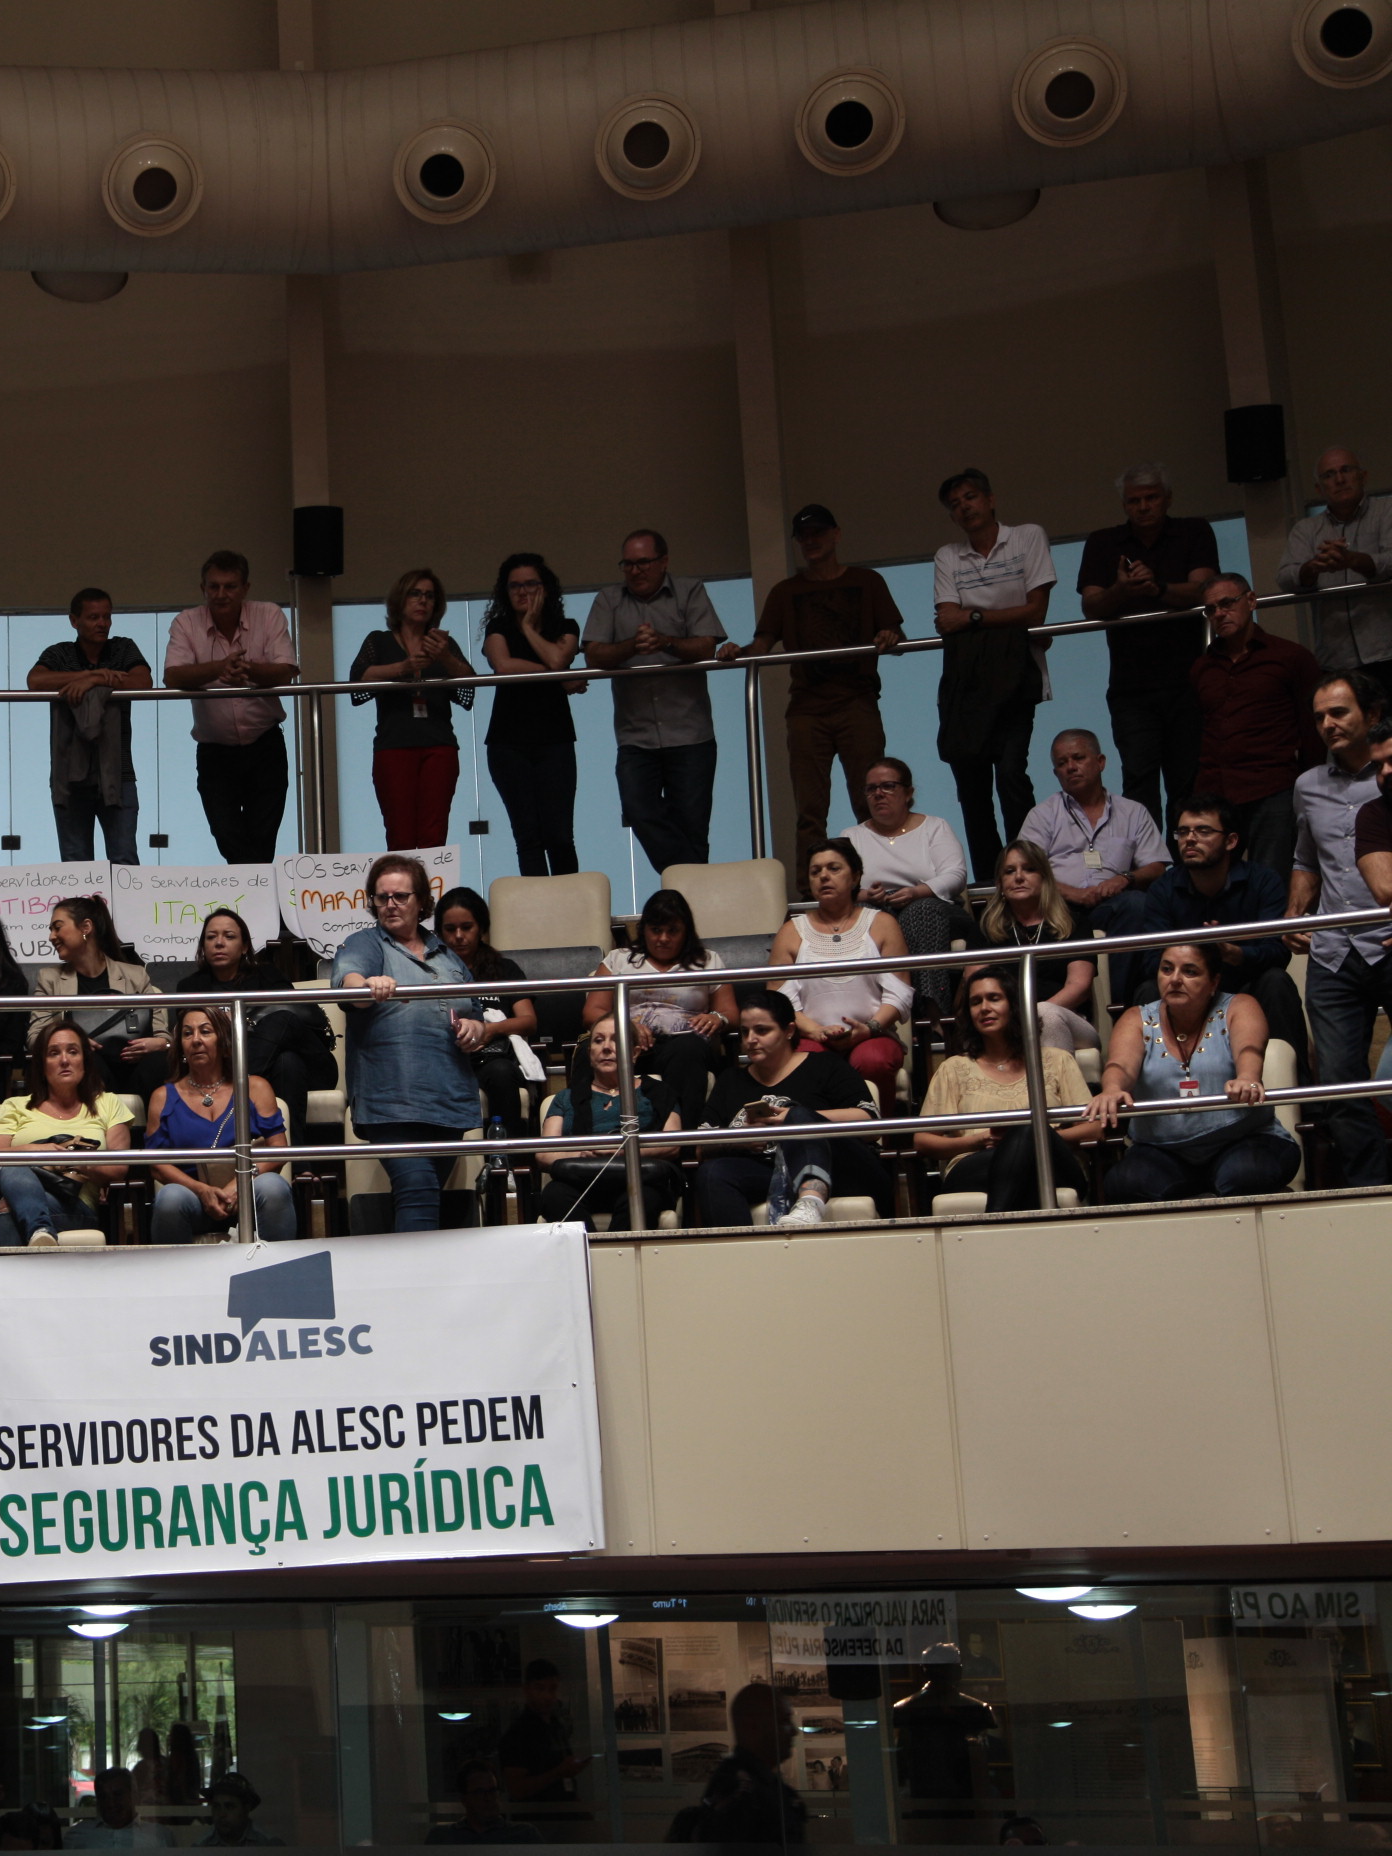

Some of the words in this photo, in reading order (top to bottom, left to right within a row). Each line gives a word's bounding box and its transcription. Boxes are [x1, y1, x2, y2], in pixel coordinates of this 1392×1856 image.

[433, 851, 454, 865] de
[84, 872, 104, 885] de
[248, 874, 269, 887] de
[149, 1323, 373, 1367] SINDALESC
[231, 1412, 280, 1458] DA
[291, 1404, 405, 1454] ALESC
[416, 1394, 544, 1446] PEDEM
[323, 1457, 555, 1539] JURÍDICA
